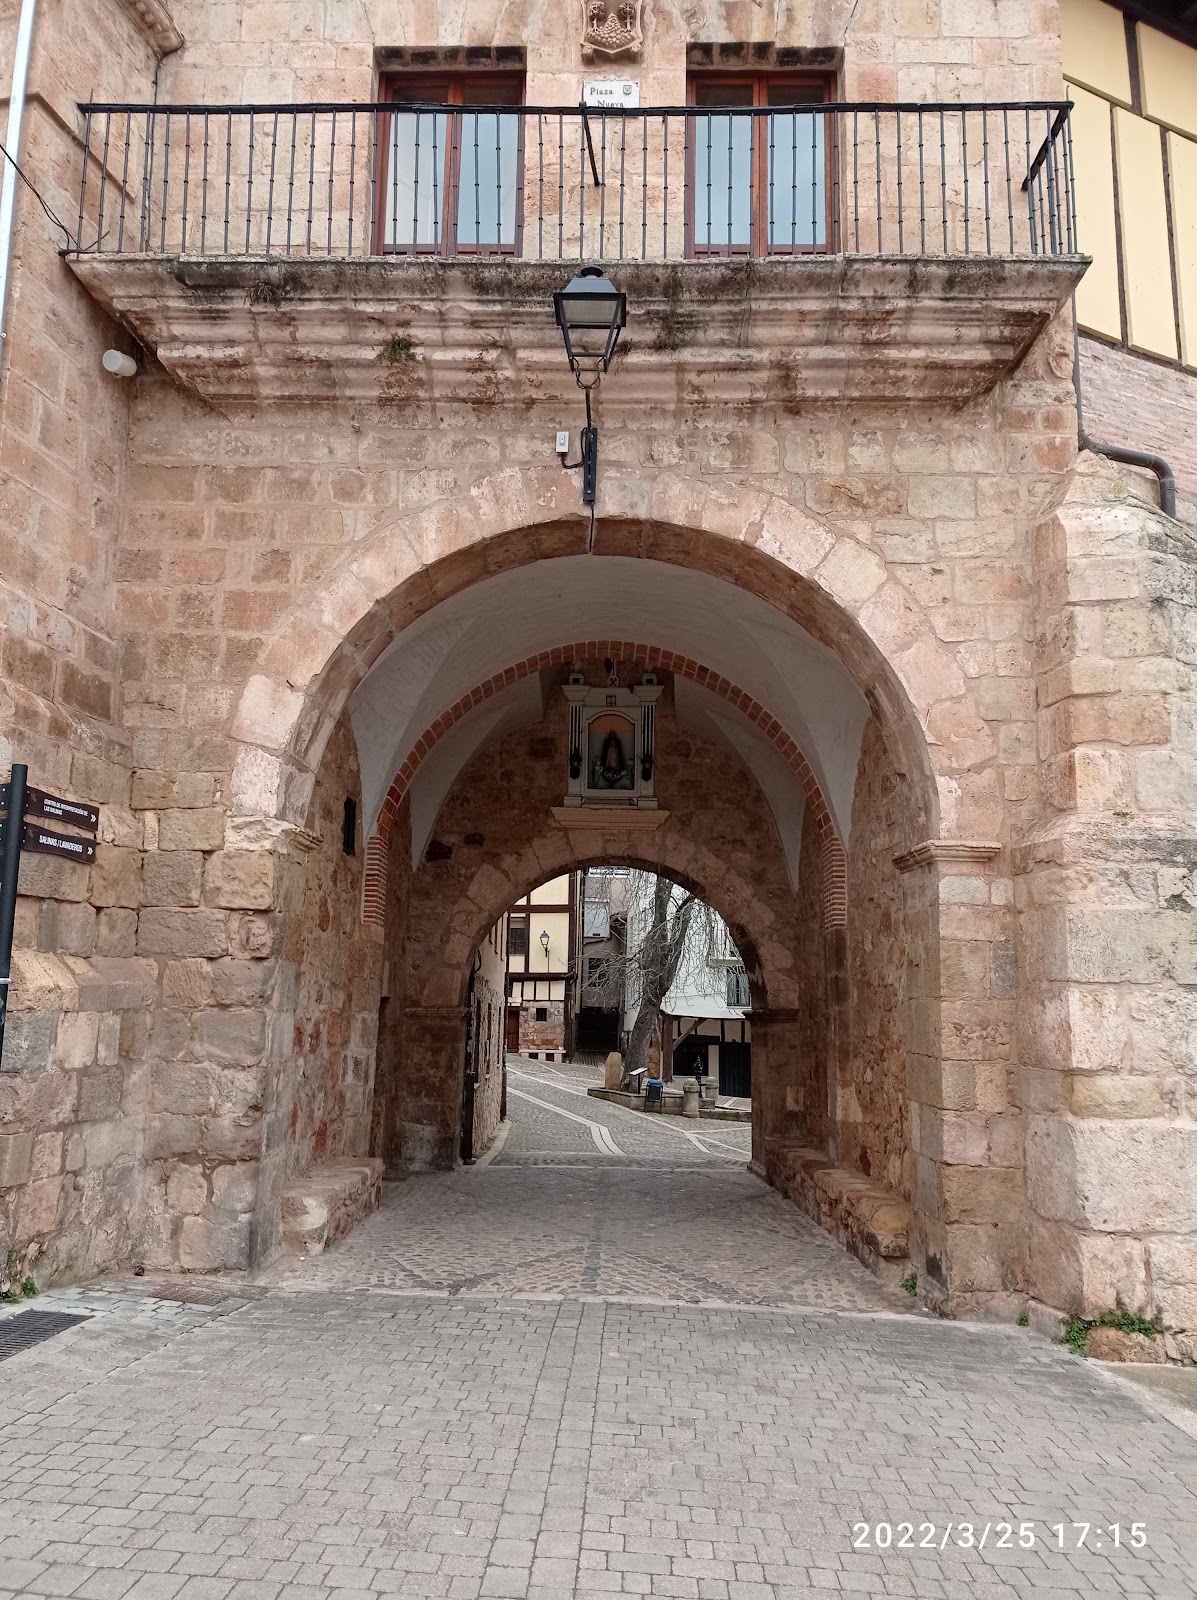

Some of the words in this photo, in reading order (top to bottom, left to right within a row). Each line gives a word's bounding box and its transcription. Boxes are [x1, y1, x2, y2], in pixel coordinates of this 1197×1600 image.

[590, 87, 614, 95] Plaza
[597, 100, 624, 108] Nueva
[39, 835, 57, 846] SALINAS
[59, 839, 83, 853] LAVADEROS
